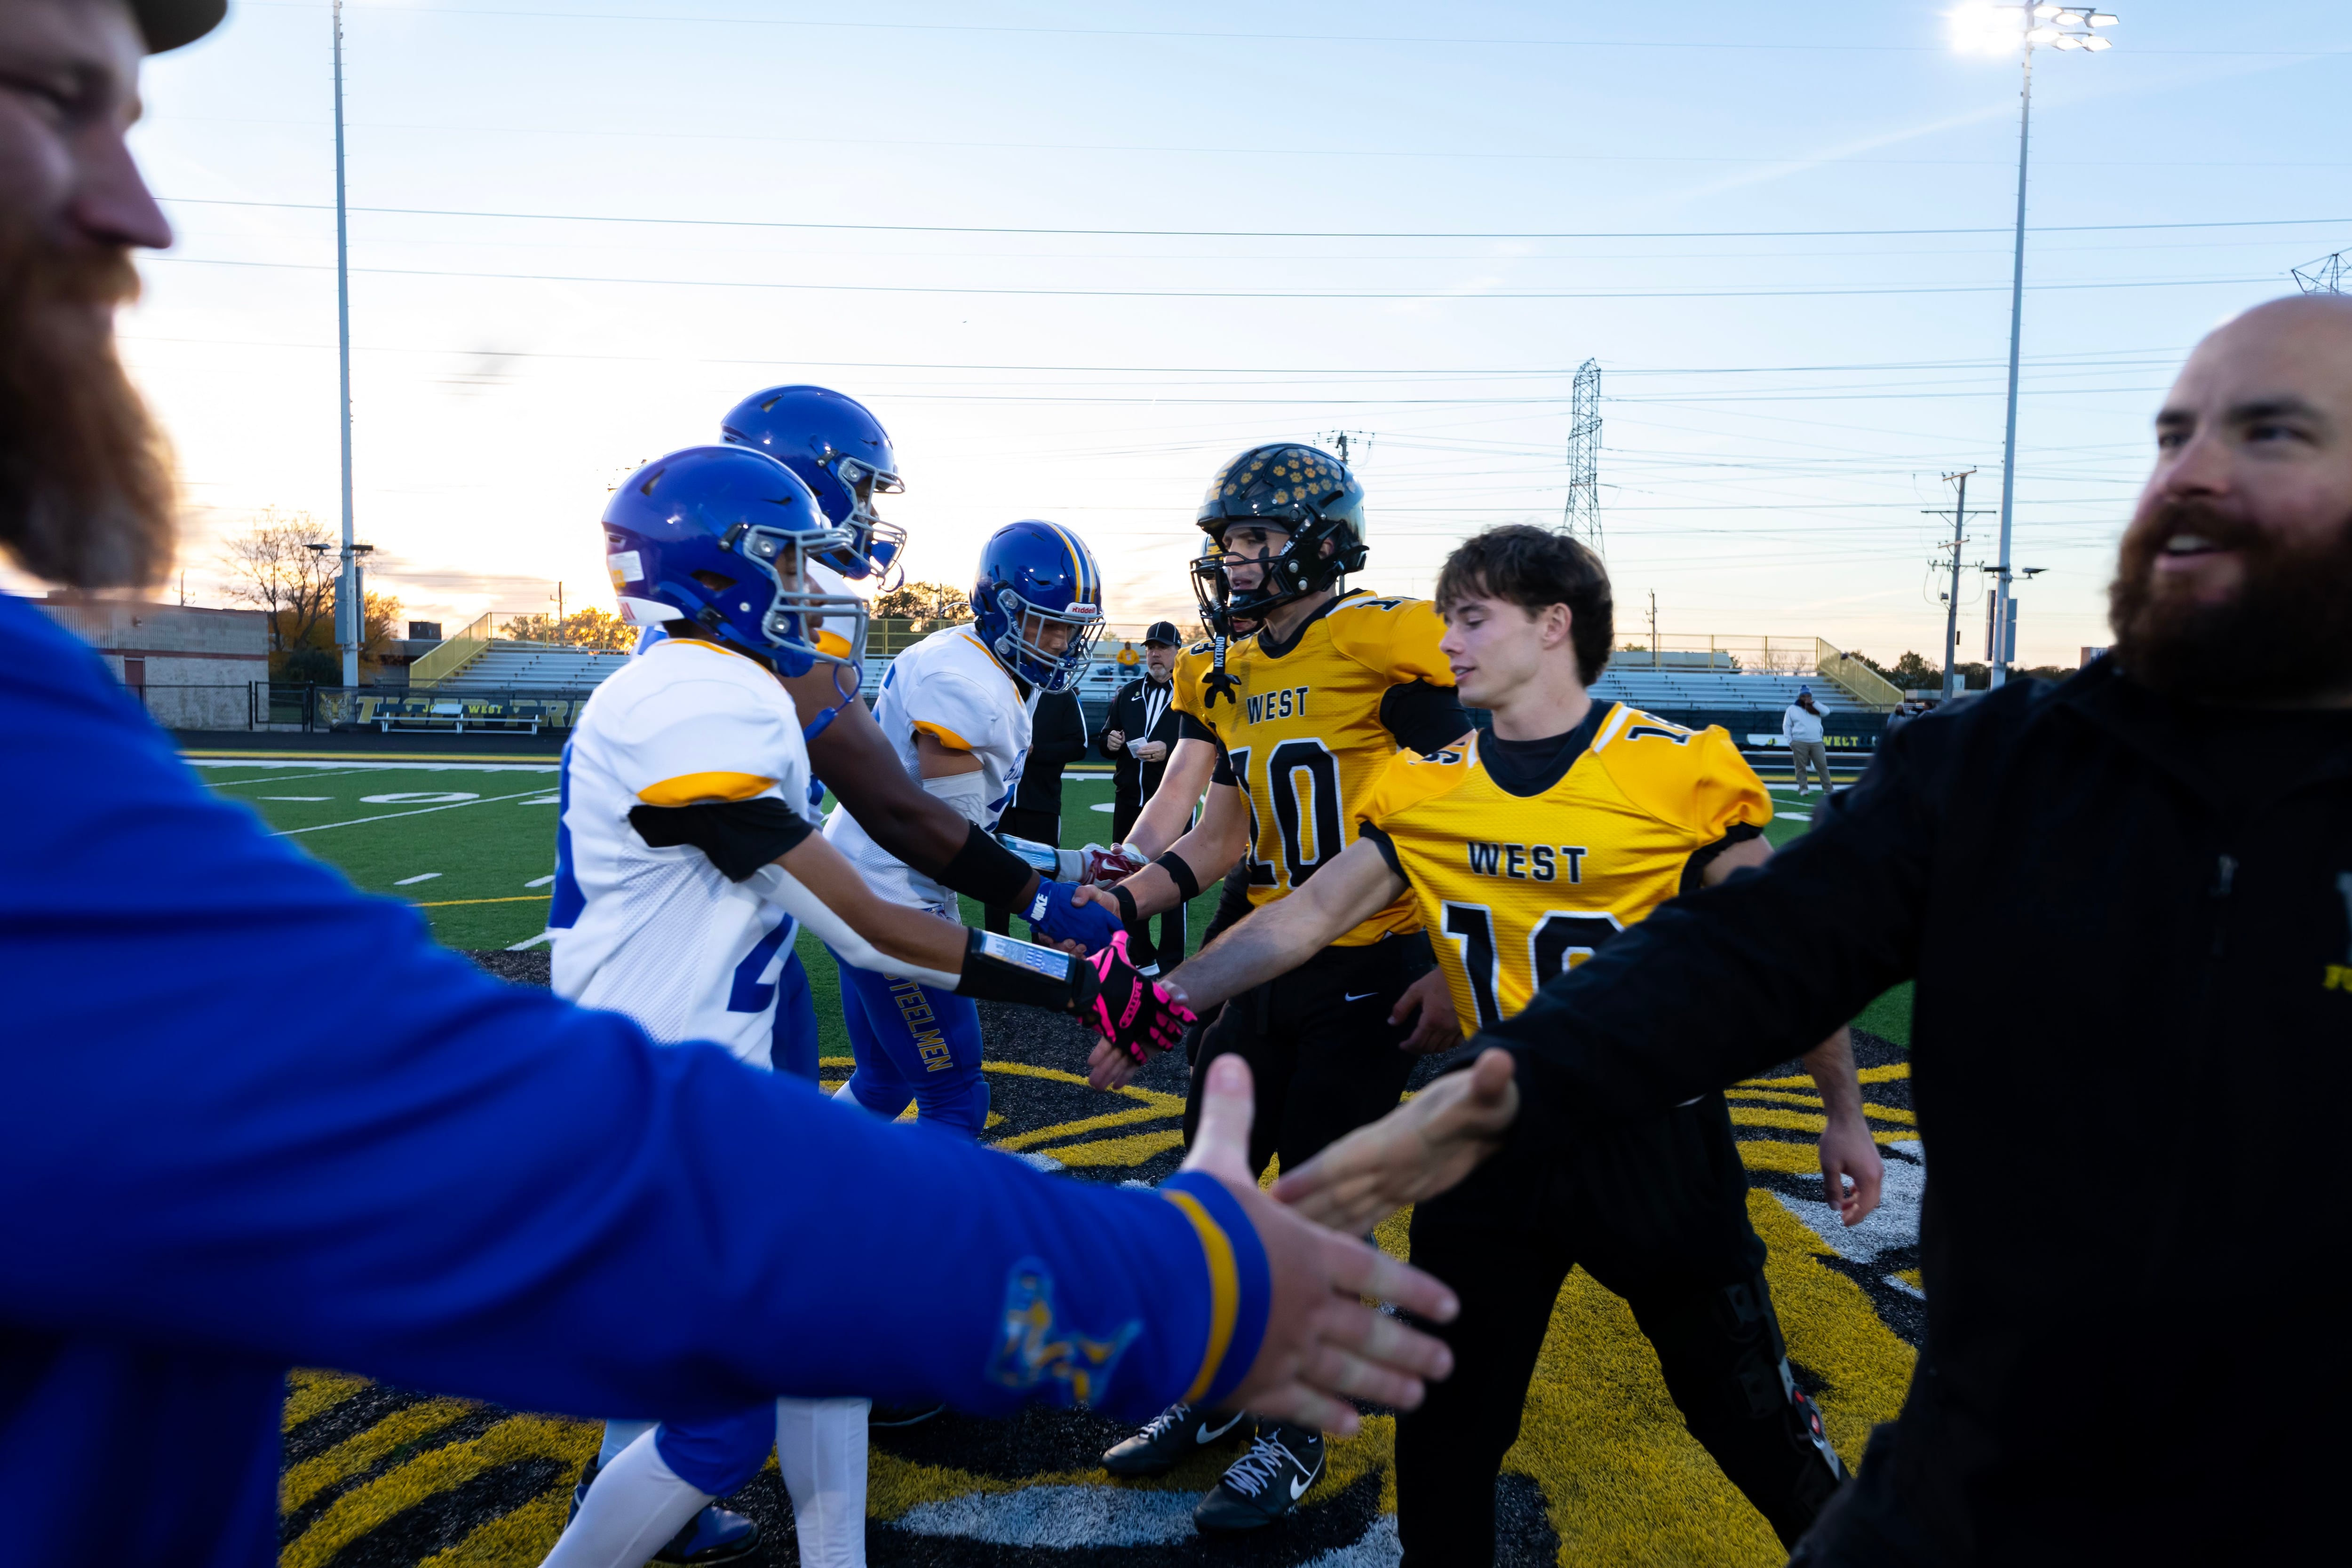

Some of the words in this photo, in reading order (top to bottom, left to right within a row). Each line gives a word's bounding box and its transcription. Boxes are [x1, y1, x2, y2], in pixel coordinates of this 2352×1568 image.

[1011, 620, 1022, 637] Ridd
[1214, 636, 1225, 667] NXTRND
[469, 705, 503, 714] WEST
[1246, 685, 1309, 726] WEST
[1228, 737, 1347, 890] 10
[1467, 841, 1588, 885] WEST
[1030, 893, 1048, 921] NIKE
